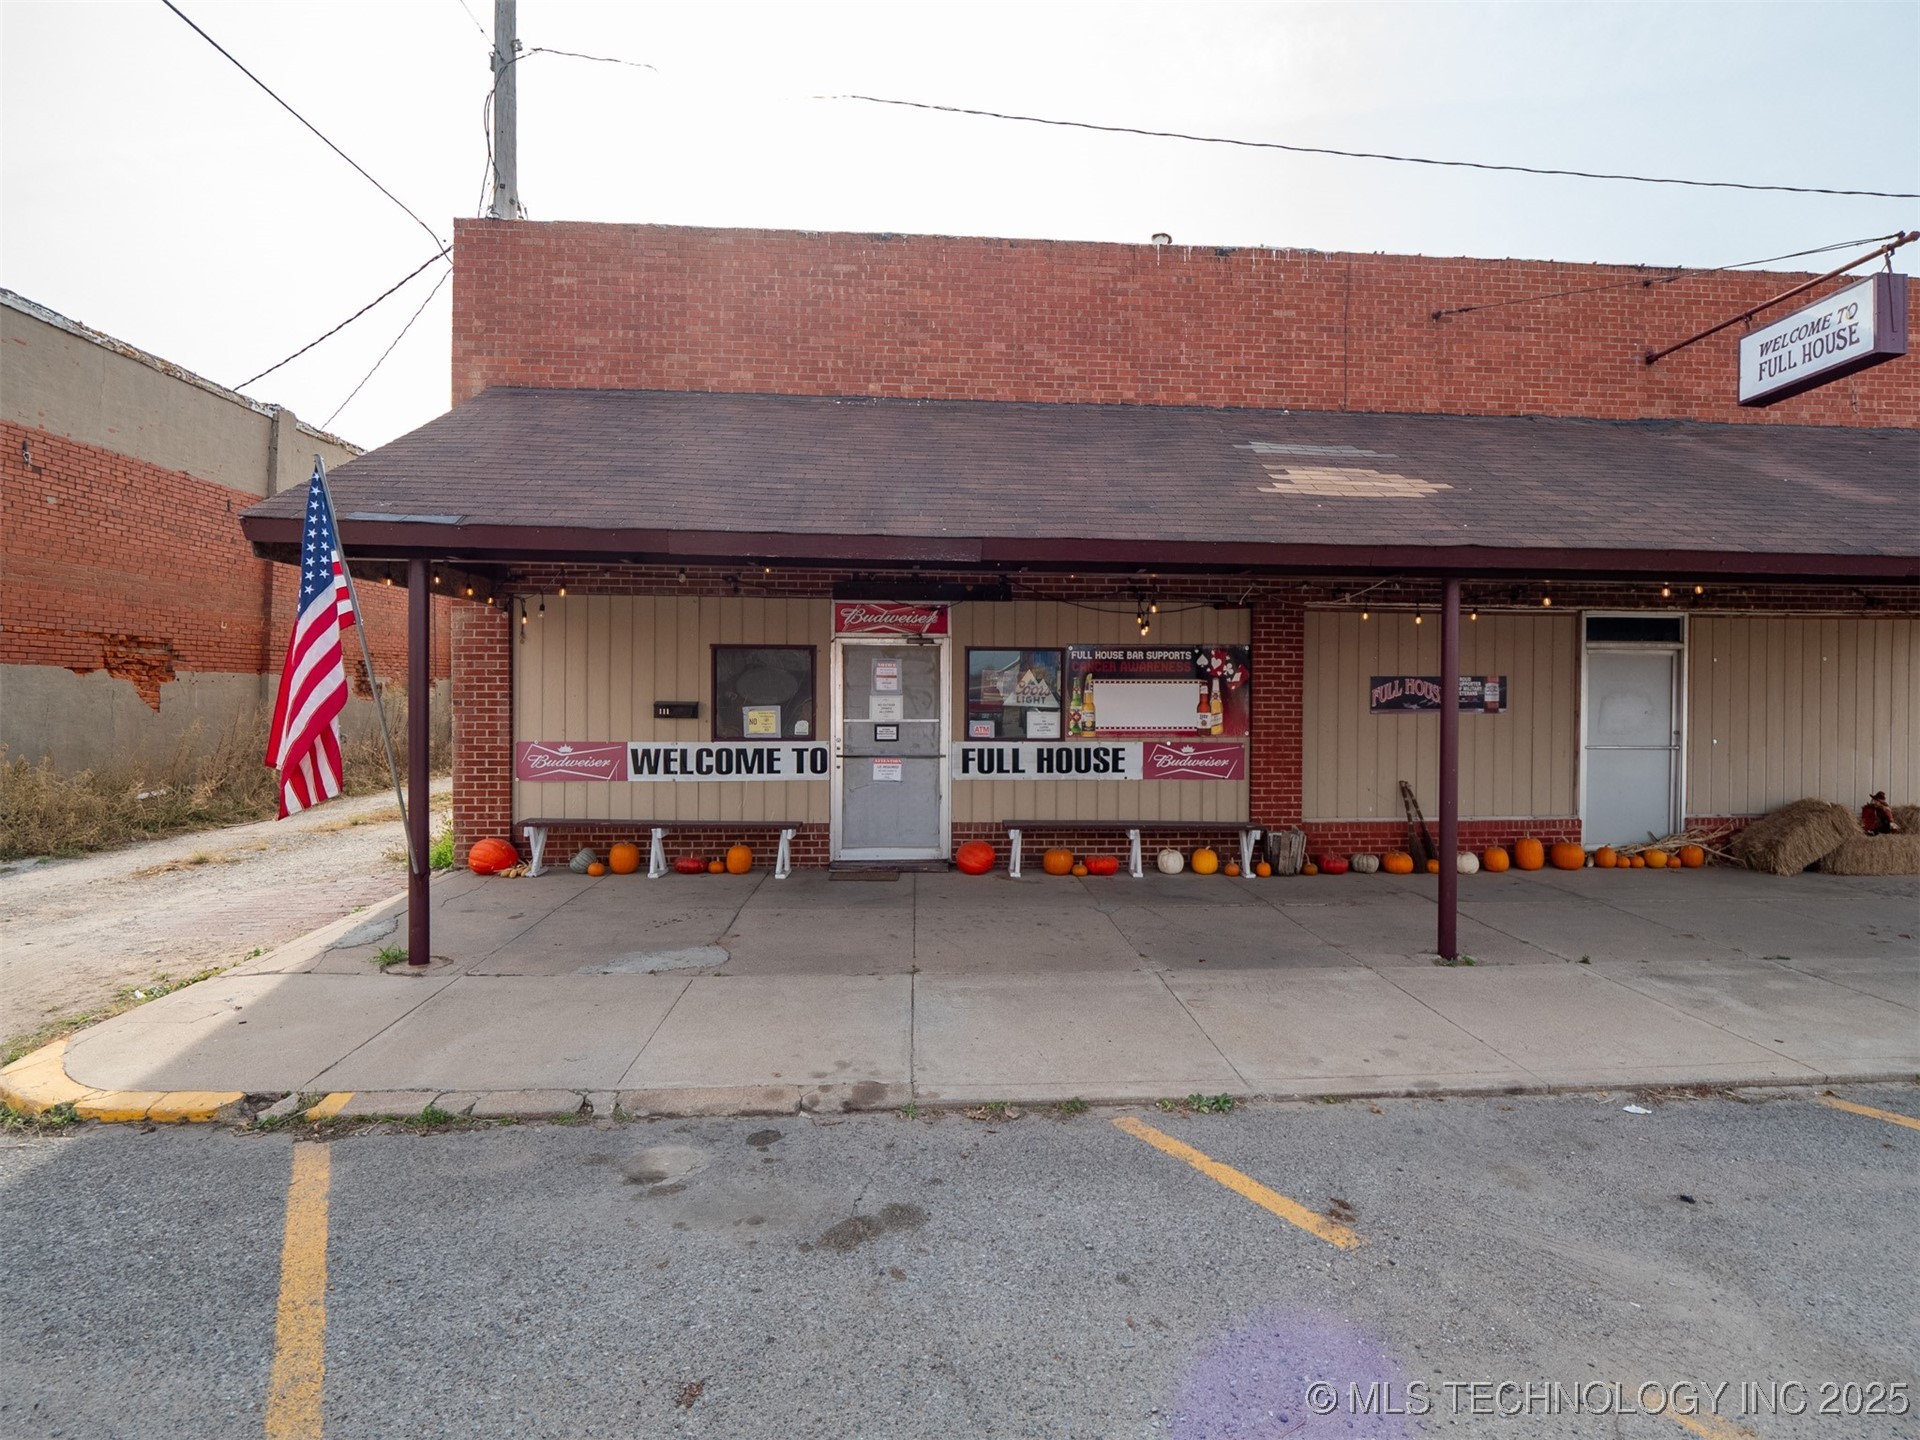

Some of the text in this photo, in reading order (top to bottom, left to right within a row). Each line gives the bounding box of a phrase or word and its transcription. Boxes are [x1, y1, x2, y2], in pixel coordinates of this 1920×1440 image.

[1759, 302, 1858, 358] WELCOME TO
[1758, 322, 1860, 382] FULL HOUSE
[841, 607, 938, 625] Budweiser
[1071, 651, 1192, 660] FULL HOUSE BAR SUPPORTS
[1072, 662, 1192, 672] CANCER AWARENESS
[1016, 681, 1051, 696] Coors
[1371, 678, 1441, 707] FULL HOUS
[1016, 696, 1046, 704] LIGHT
[749, 718, 758, 726] NO
[527, 754, 611, 769] Budweiser
[630, 747, 828, 775] WELCOME TO
[961, 747, 1126, 774] FULL HOUSE
[1153, 753, 1230, 769] Budweiser
